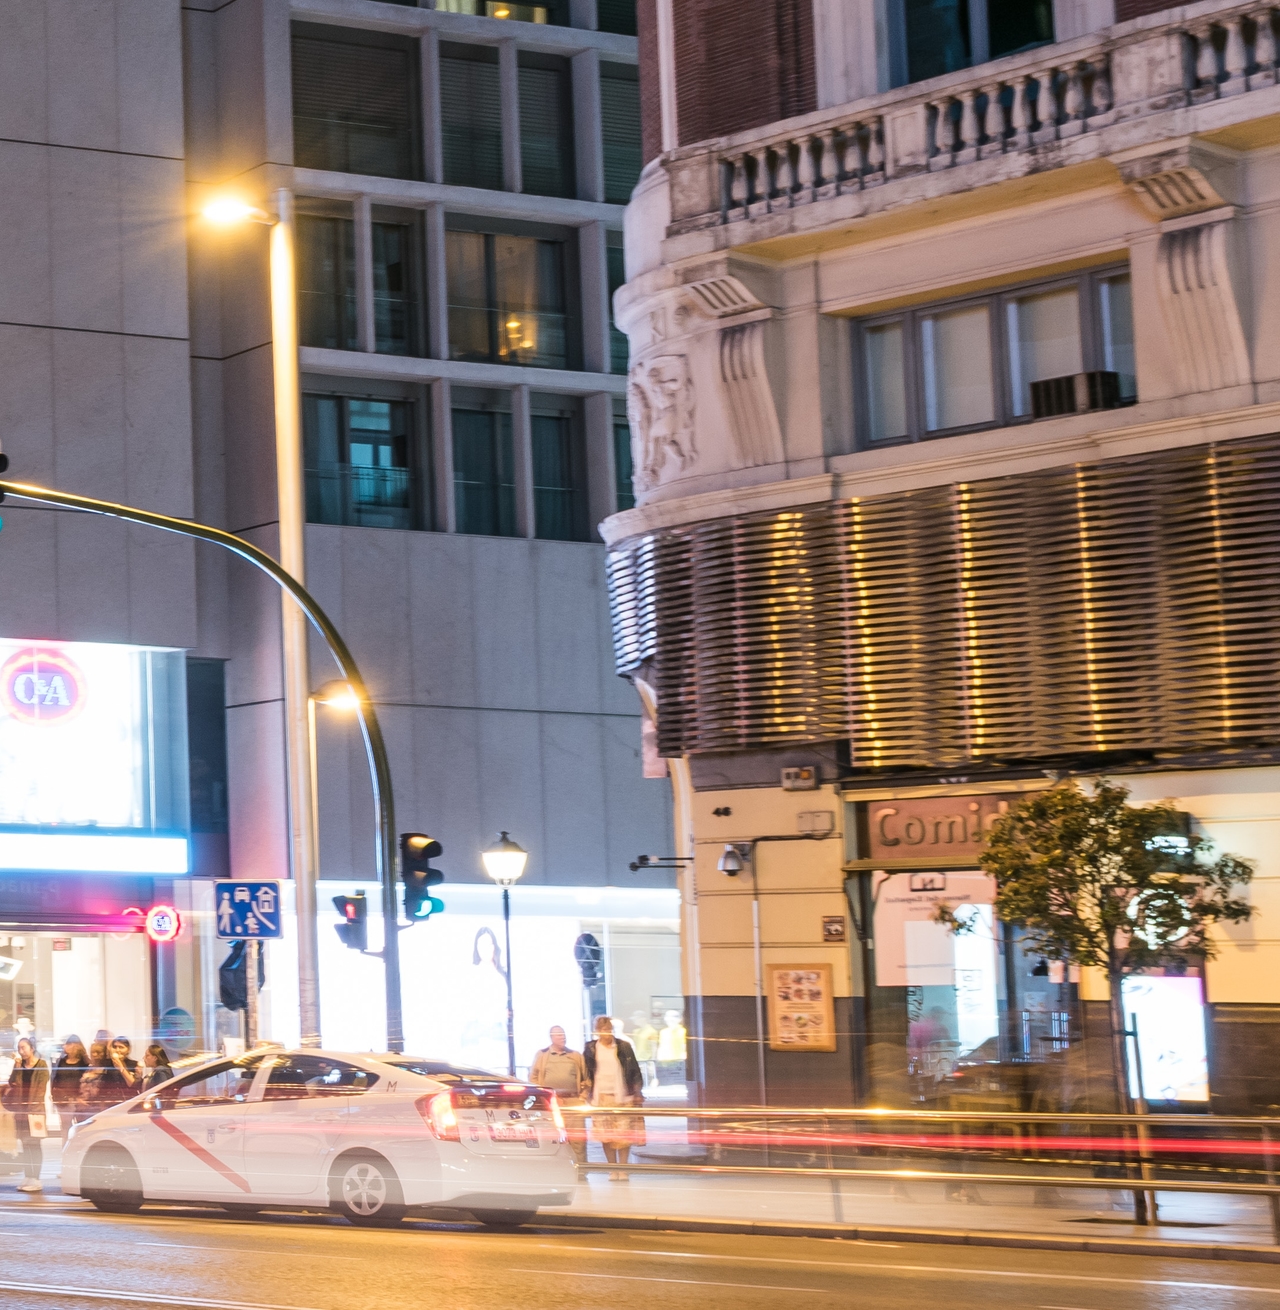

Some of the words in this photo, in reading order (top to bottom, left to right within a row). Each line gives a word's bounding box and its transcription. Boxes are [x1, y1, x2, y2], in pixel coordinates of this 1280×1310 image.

[14, 674, 71, 706] C&A
[386, 1080, 398, 1092] M
[484, 1109, 496, 1122] M
